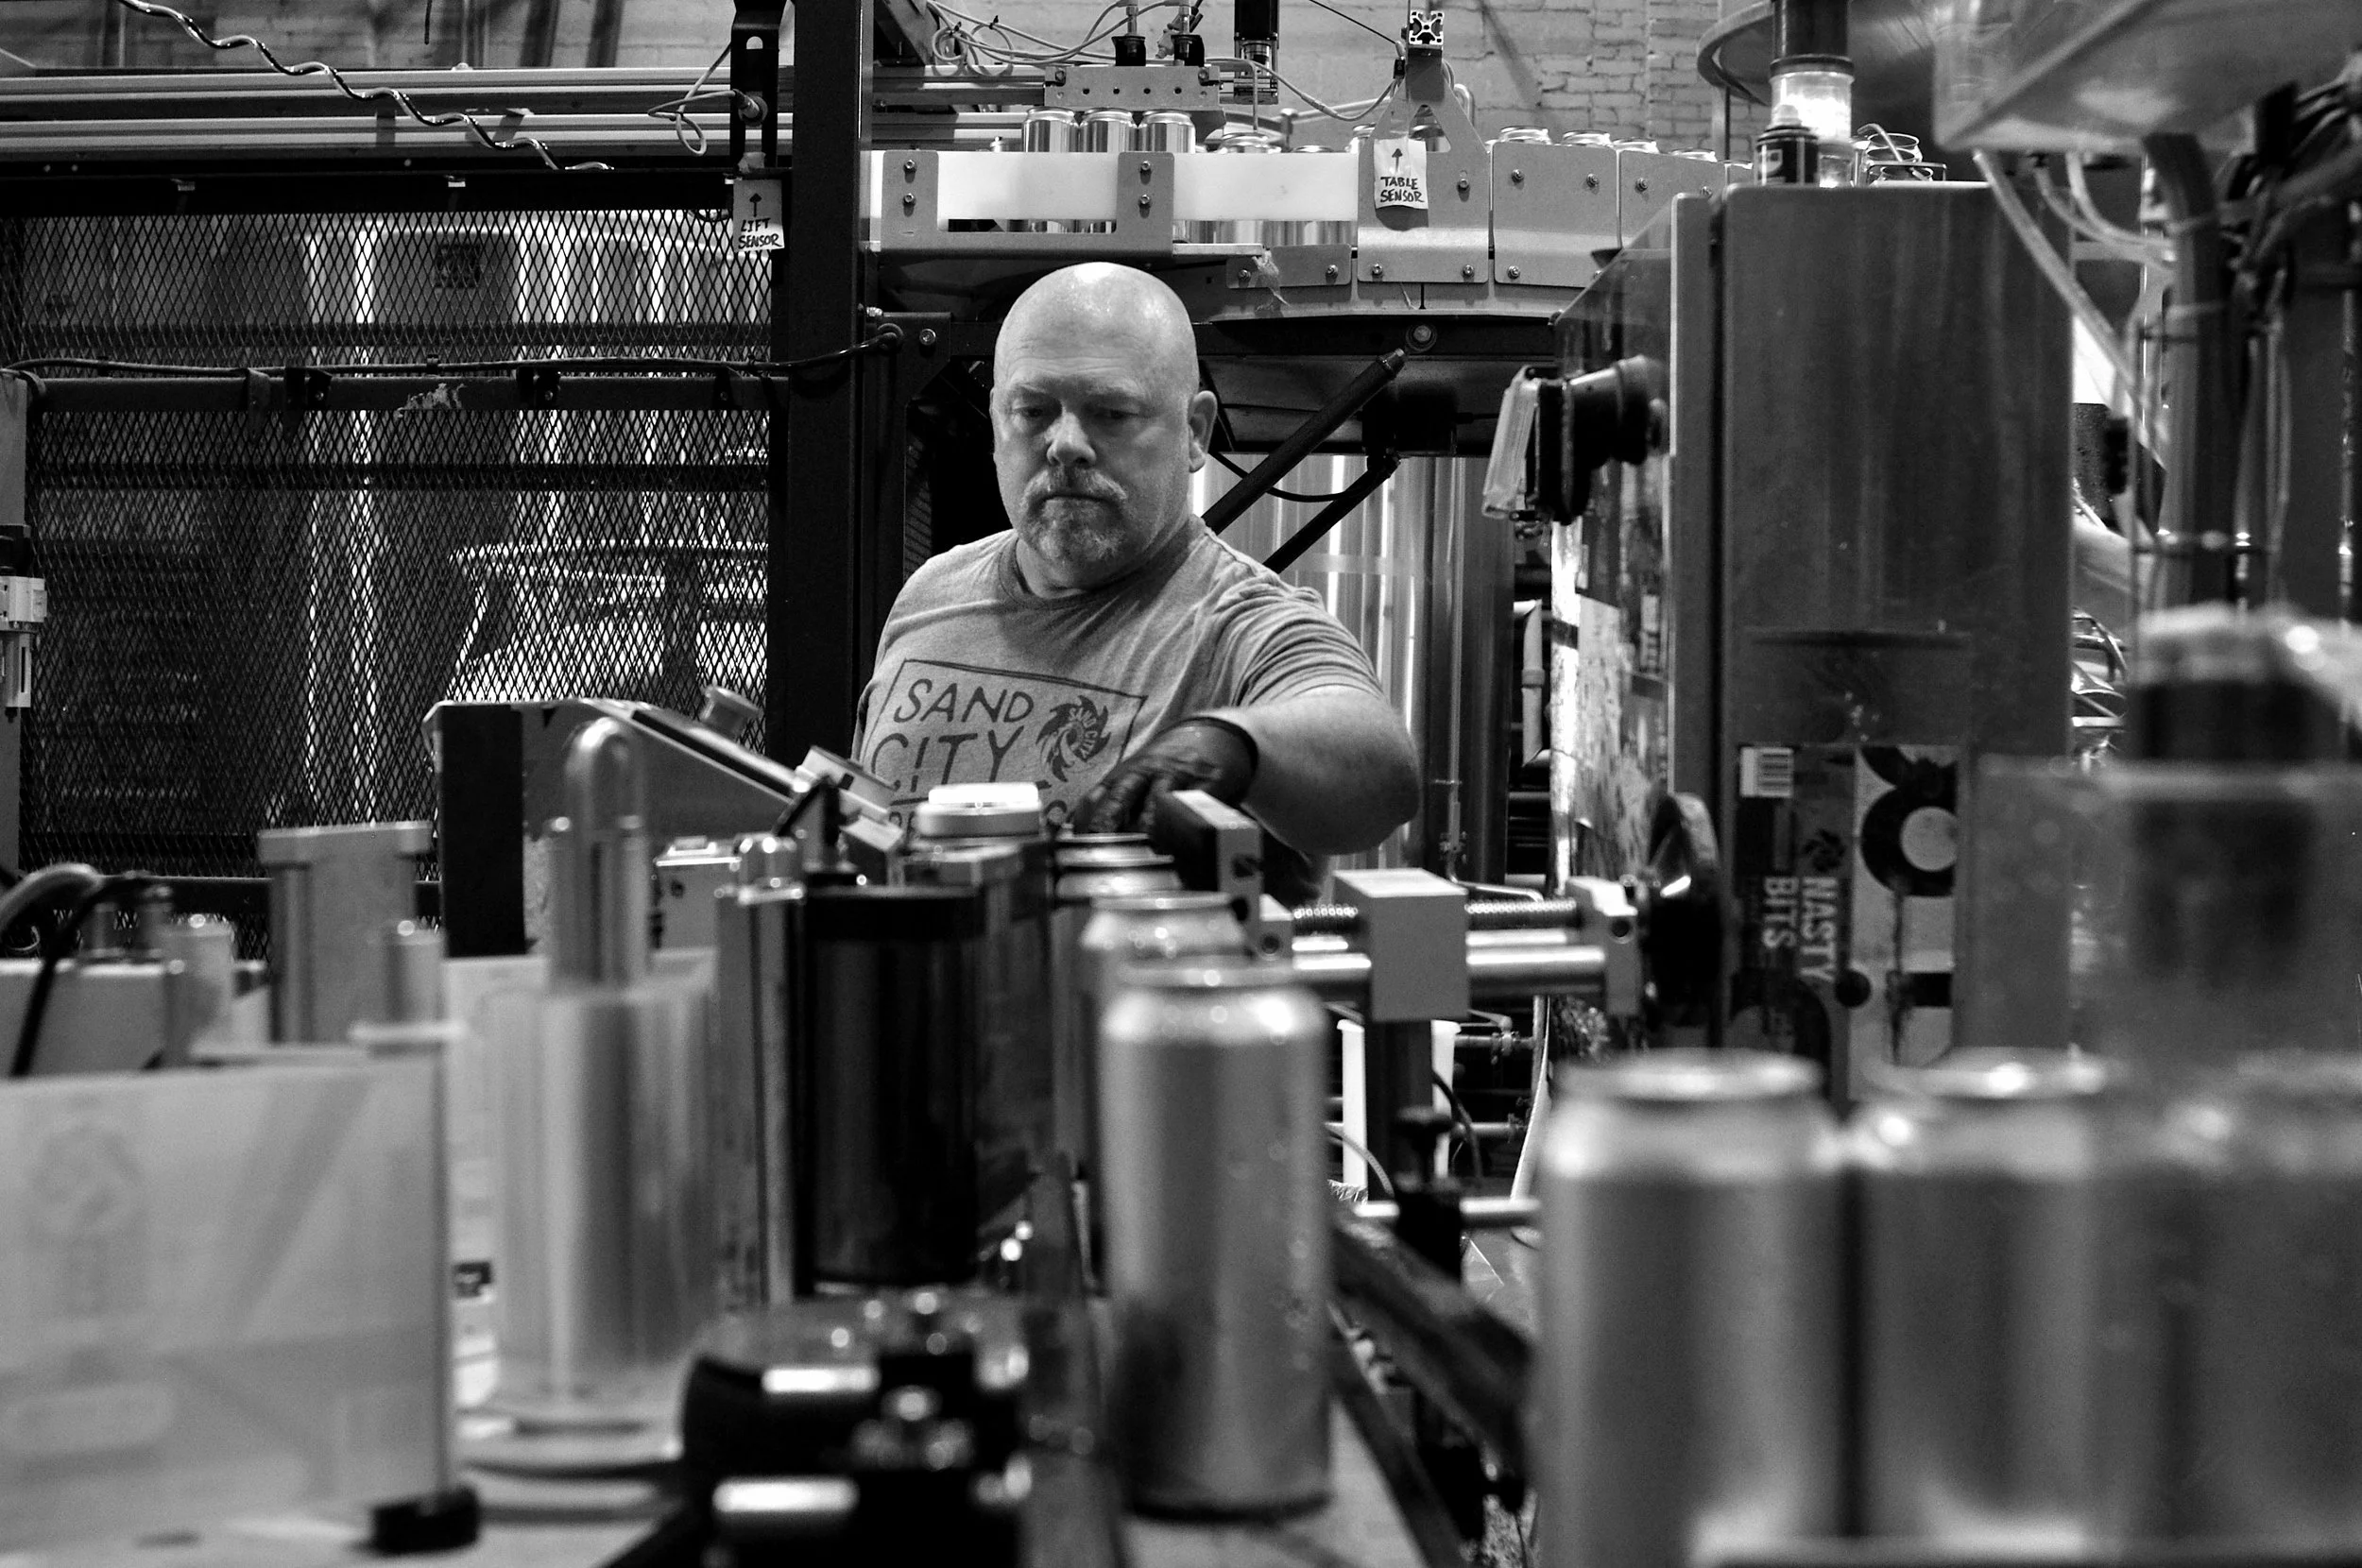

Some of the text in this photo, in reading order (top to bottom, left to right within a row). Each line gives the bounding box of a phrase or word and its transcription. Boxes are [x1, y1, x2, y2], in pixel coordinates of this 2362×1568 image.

[1380, 176, 1418, 190] TABLE
[1380, 188, 1425, 203] SENSOR
[738, 233, 782, 249] SENSOR
[741, 217, 771, 232] LIFT
[893, 678, 1035, 724] SAND
[1069, 707, 1098, 758] SAND CITY
[871, 725, 1024, 793] CITY
[1763, 876, 1798, 948] BITS
[1799, 876, 1837, 980] NASTY
